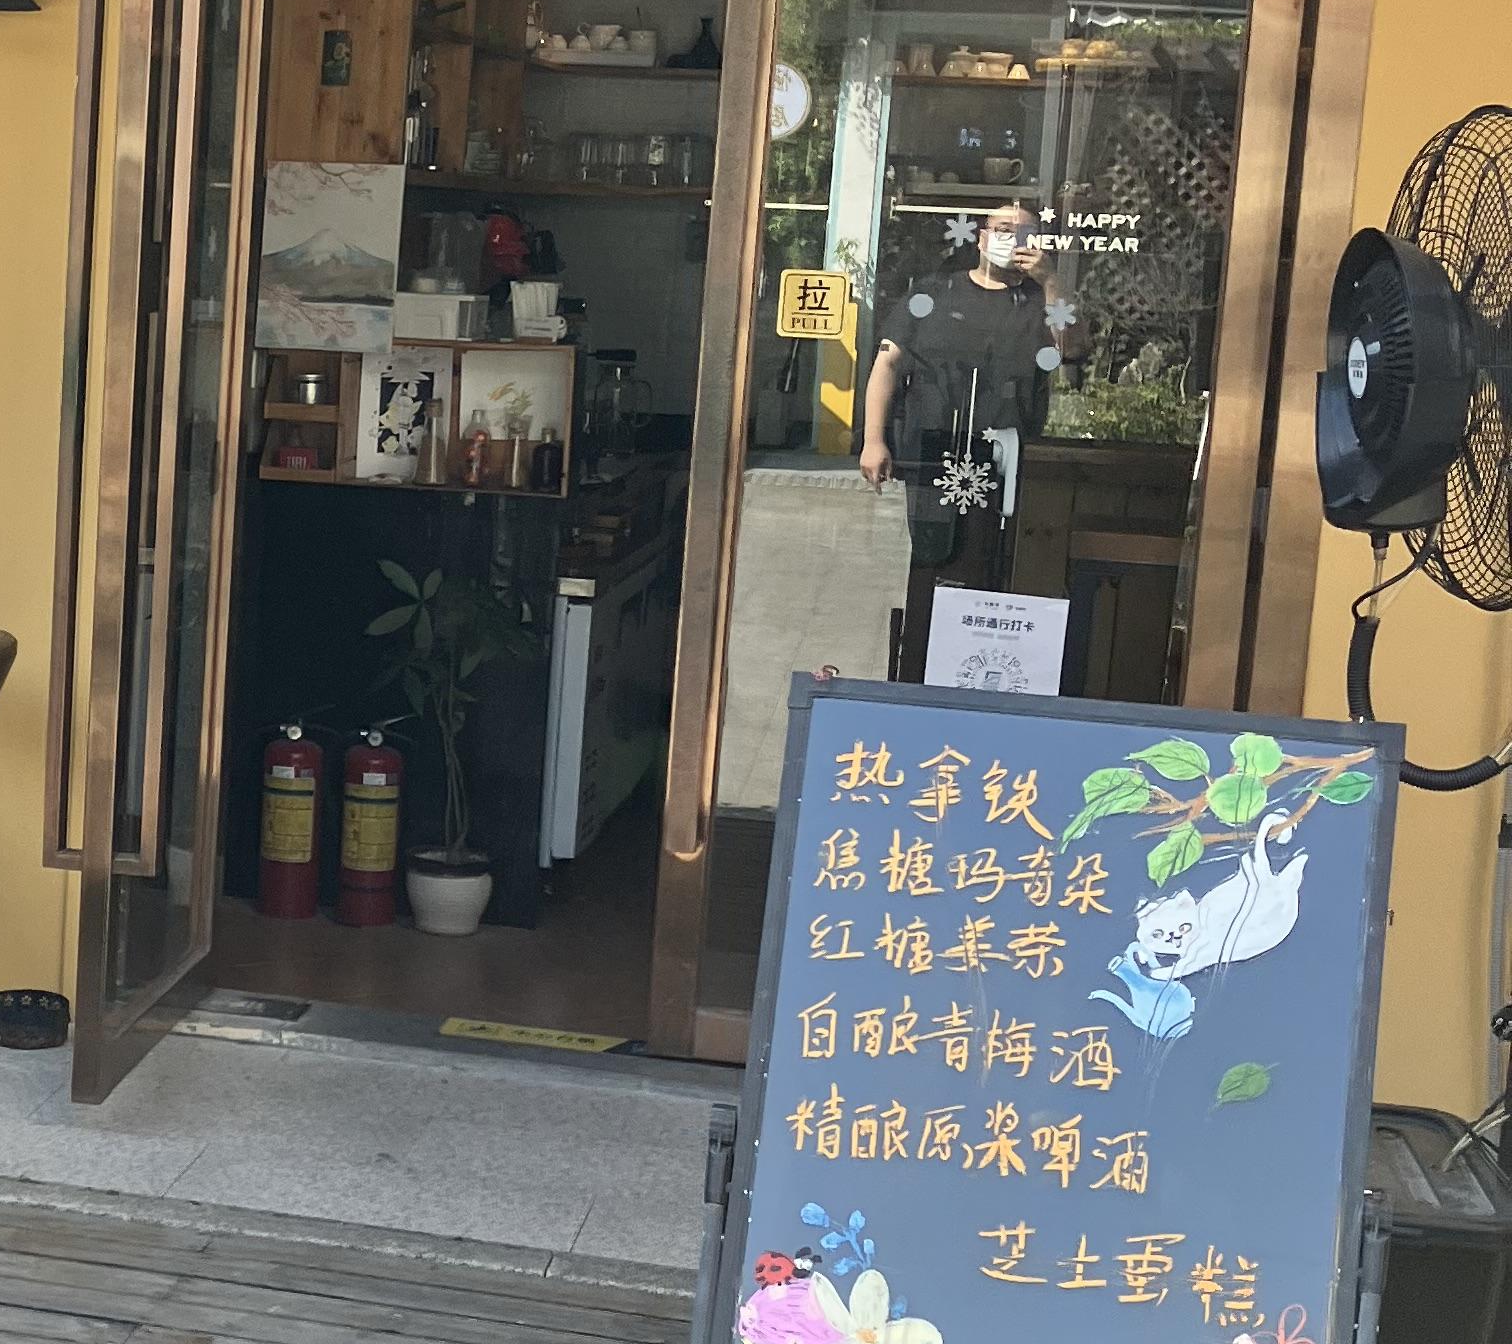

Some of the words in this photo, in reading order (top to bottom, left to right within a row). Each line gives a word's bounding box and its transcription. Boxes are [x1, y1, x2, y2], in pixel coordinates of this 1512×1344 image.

[1025, 233, 1074, 251] NEW
[1079, 236, 1139, 253] YEAR
[1067, 212, 1141, 230] HAPPY
[791, 317, 833, 331] PULL
[797, 278, 831, 311] 拉
[829, 740, 1055, 842] 热拿铁
[812, 827, 1114, 915] 焦糖玛奇朵
[809, 911, 1068, 979] 红糖姜茶
[797, 991, 1123, 1092] 自酿青梅酒
[786, 1081, 1151, 1195] 精酿原浆啤酒
[977, 1220, 1266, 1329] 芝士蛋糕
